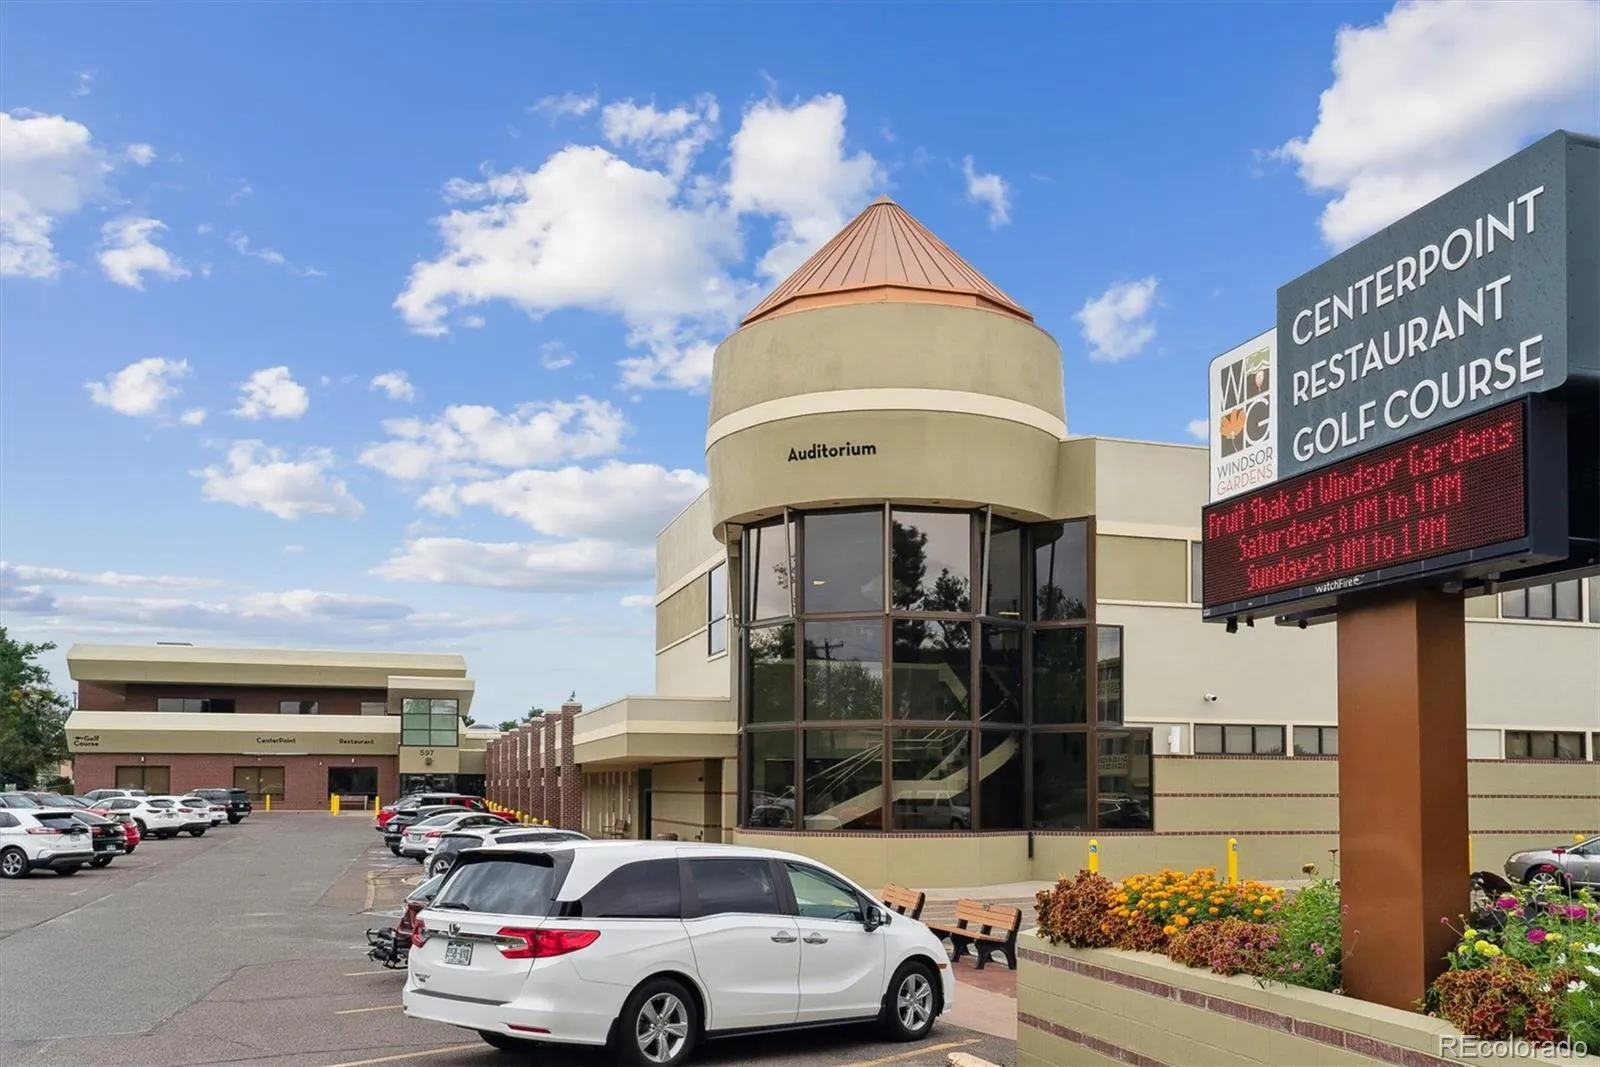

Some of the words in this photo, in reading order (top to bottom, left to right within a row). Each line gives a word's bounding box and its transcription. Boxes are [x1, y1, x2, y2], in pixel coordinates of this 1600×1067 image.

[1292, 185, 1545, 346] CENTERPOINT
[1292, 274, 1512, 408] RESTAURANT
[1292, 400, 1377, 462] GOLF
[1384, 334, 1545, 429] COURSE
[787, 441, 877, 462] Auditorium
[1216, 446, 1273, 479] WINDSOR
[1208, 503, 1246, 539] Fruit
[1250, 490, 1290, 526] Shak
[1294, 480, 1313, 512] at
[1319, 456, 1401, 504] Windsor
[1408, 421, 1514, 476] Gardens
[1216, 463, 1273, 496] GARDENS
[1238, 512, 1333, 561] Saturdays
[1353, 495, 1379, 530] AM
[1385, 491, 1409, 521] to
[1415, 482, 1425, 512] 4
[1432, 470, 1462, 509] PM
[1247, 554, 1322, 591] Sundays
[1341, 534, 1367, 569] AM
[1373, 531, 1395, 560] to
[1401, 523, 1412, 555] 1
[1418, 514, 1448, 552] PM
[256, 737, 296, 745] CenterPoint
[339, 738, 375, 746] Restaurant
[419, 749, 435, 757] 597
